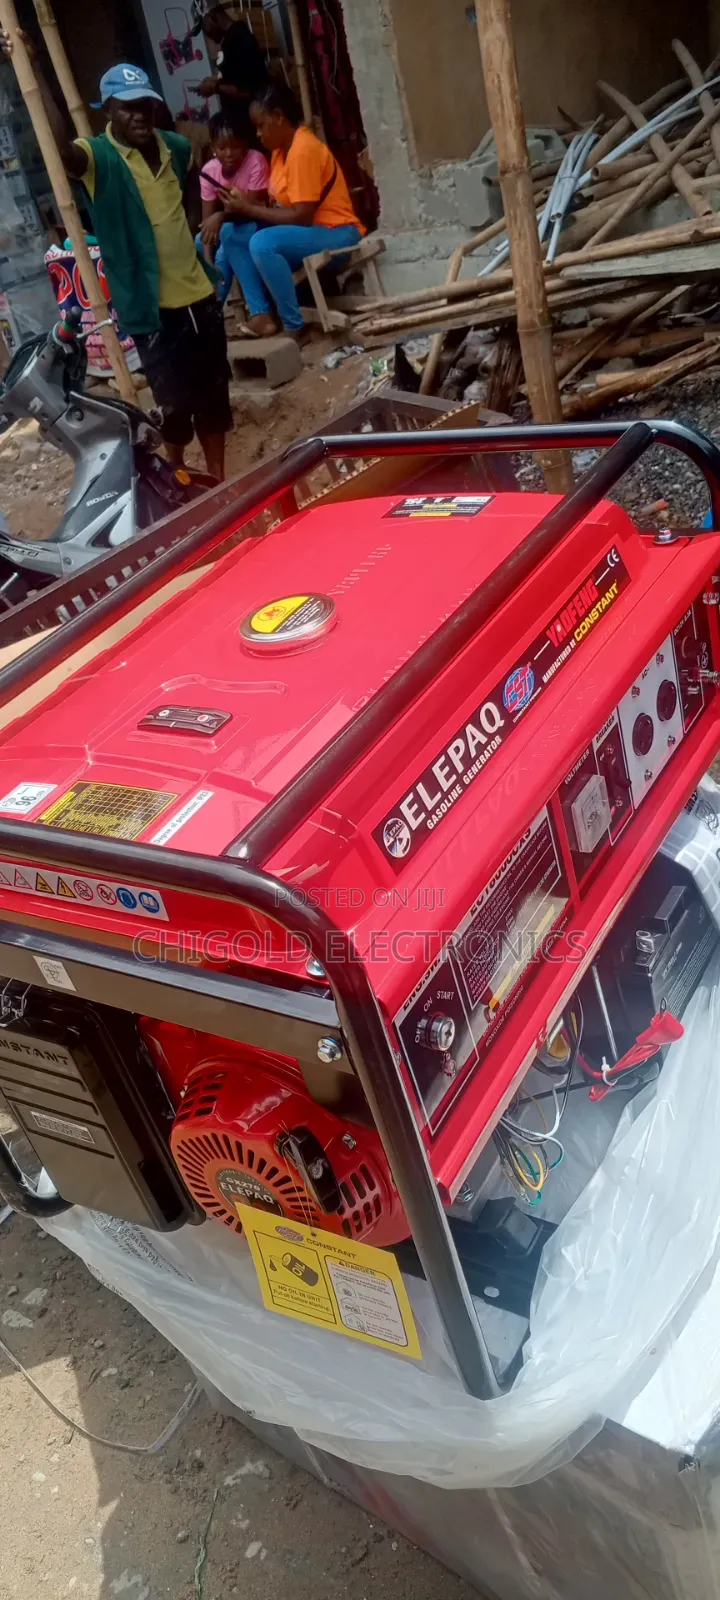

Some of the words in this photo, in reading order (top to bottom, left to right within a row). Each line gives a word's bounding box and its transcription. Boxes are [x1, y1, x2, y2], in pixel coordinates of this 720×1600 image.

[546, 577, 599, 648] YAOFENG
[542, 647, 572, 683] MANUFACTURED
[574, 581, 619, 641] CONSTANT
[399, 702, 505, 831] ELEPAQ
[564, 748, 590, 785] VOLTMETER
[426, 783, 464, 830] GASOLINE
[462, 735, 503, 786] GENERATOR
[423, 996, 433, 1012] ON
[436, 990, 455, 1001] START
[220, 1182, 274, 1204] ELEPAQ
[306, 1238, 357, 1259] CONSTANT
[291, 1262, 306, 1277] OIL
